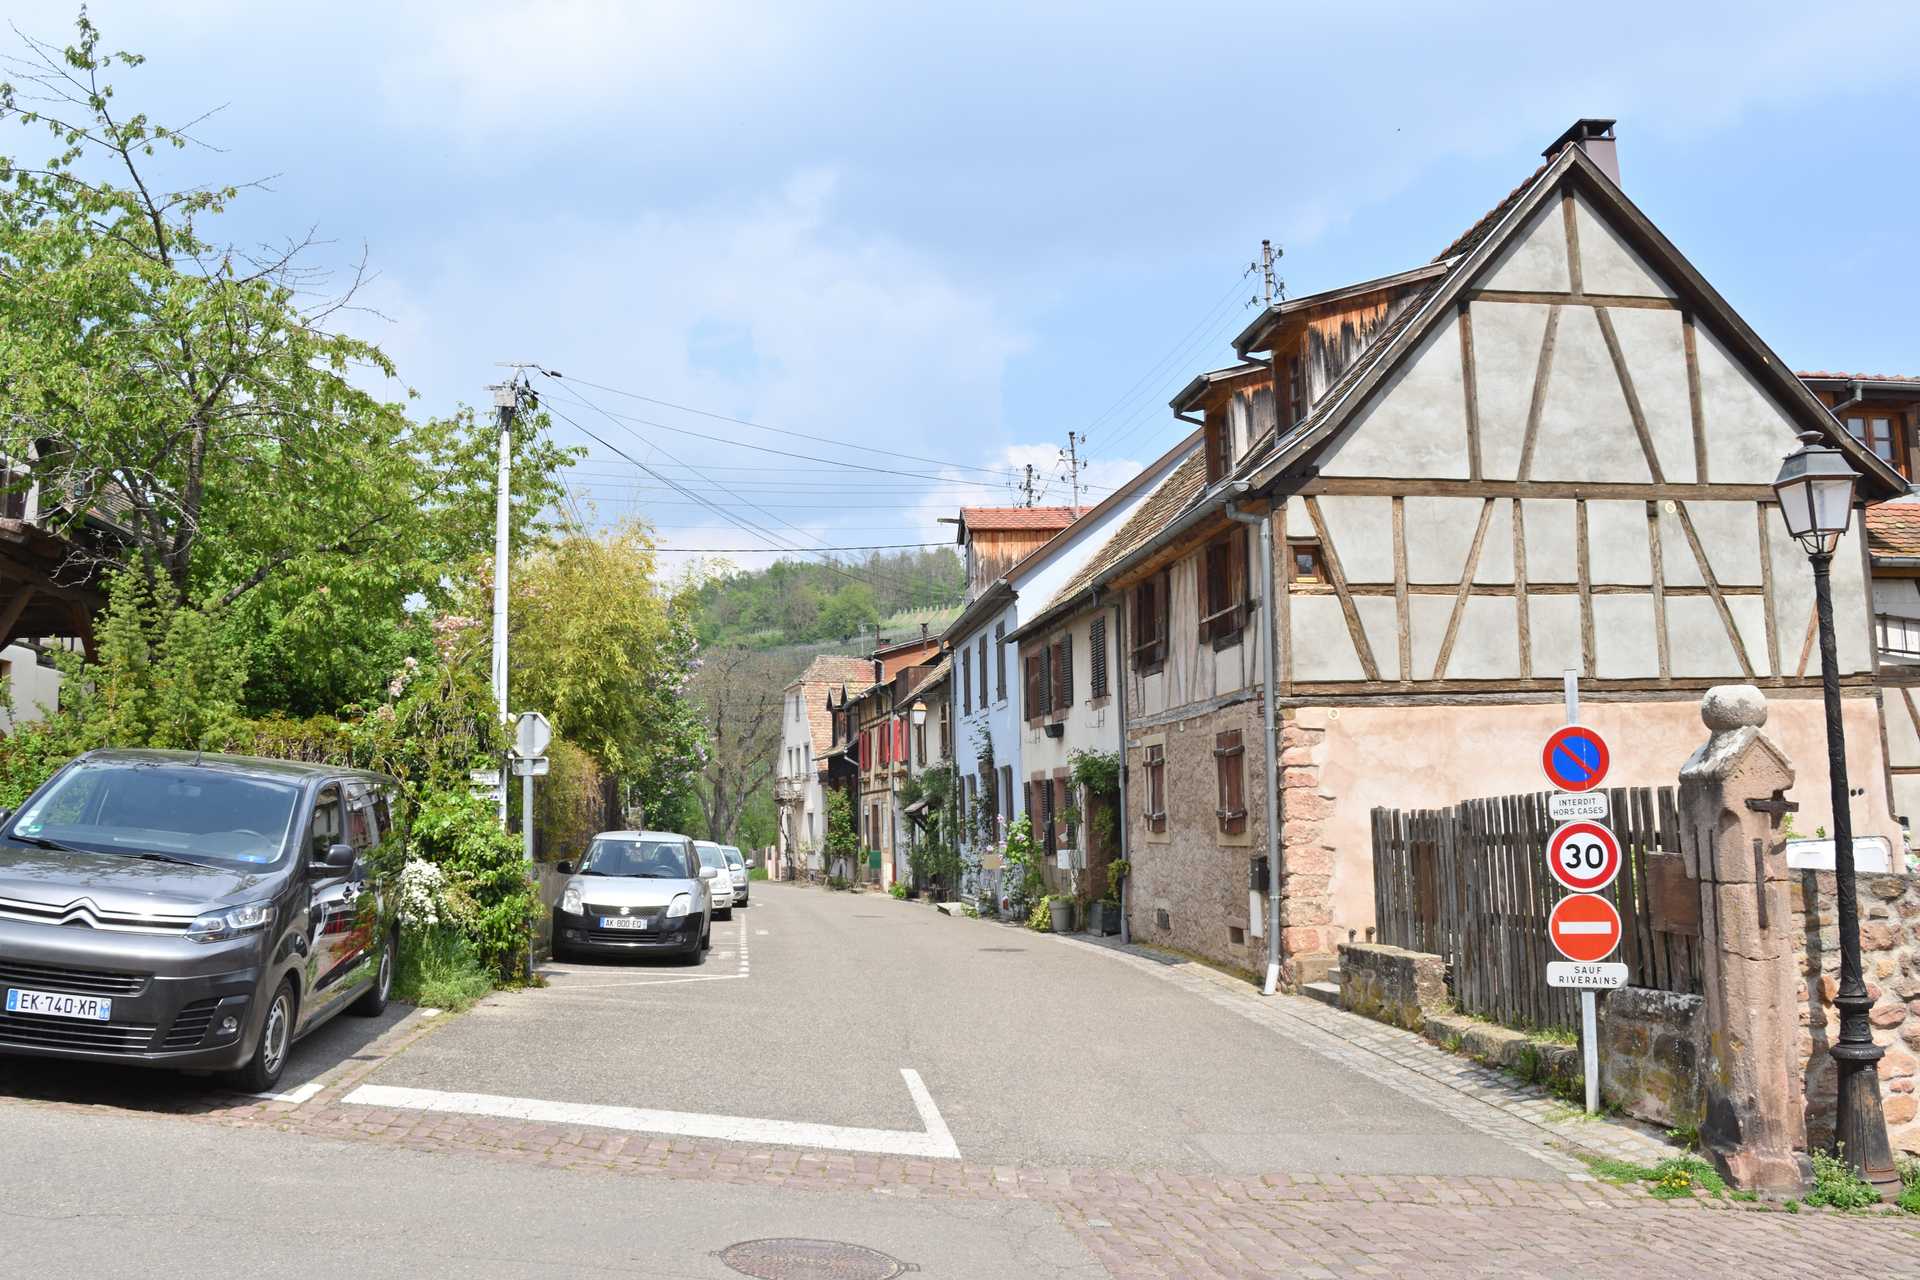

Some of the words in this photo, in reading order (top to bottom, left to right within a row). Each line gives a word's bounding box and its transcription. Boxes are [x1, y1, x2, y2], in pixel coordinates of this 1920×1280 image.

[1559, 798, 1596, 807] INTERDIT
[1553, 808, 1575, 816] HORS
[1577, 806, 1604, 815] CASES
[1564, 843, 1604, 869] 30
[1574, 966, 1602, 974] SAUF
[1558, 975, 1618, 985] RIVERAINS
